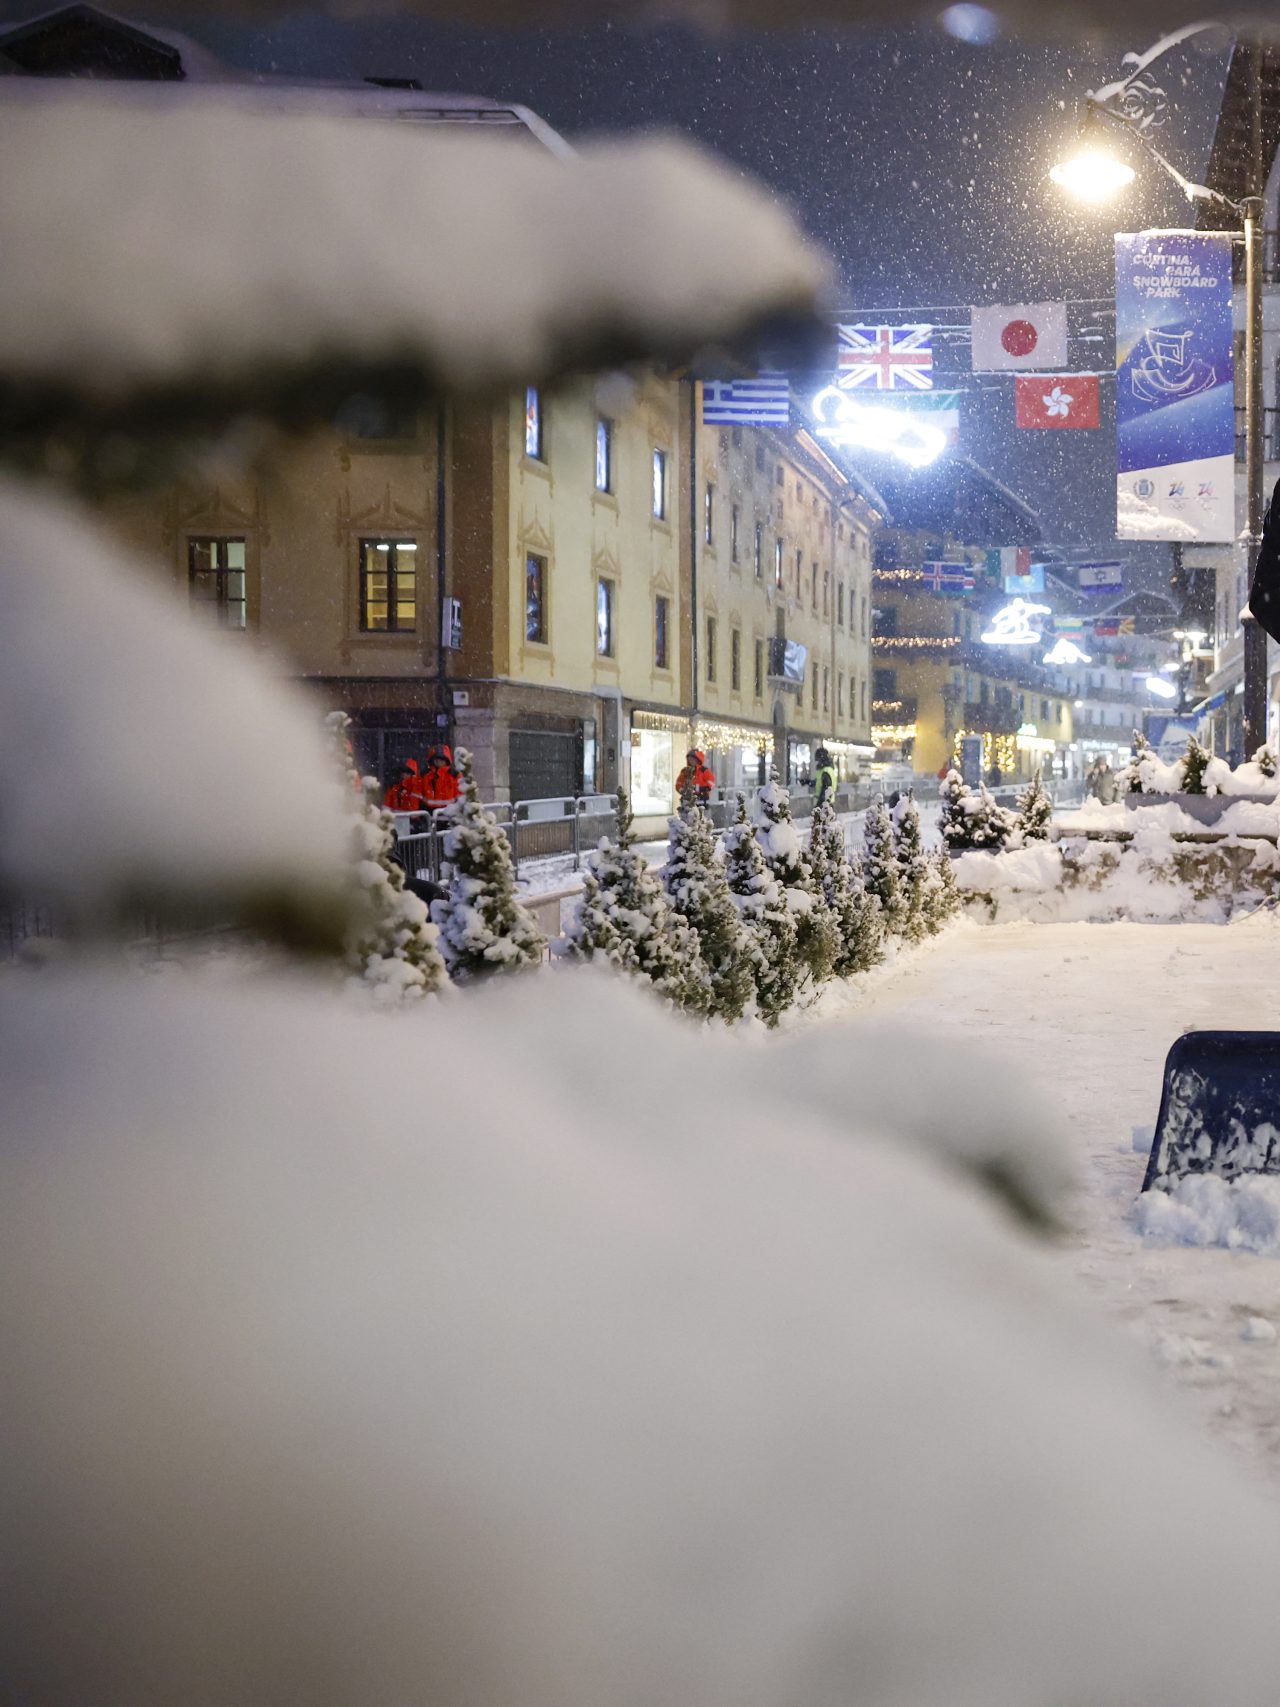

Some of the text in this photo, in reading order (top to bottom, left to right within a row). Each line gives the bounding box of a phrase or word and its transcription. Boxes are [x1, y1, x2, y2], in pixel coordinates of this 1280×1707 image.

[1133, 254, 1190, 265] CORTINA
[1133, 276, 1218, 288] SNOWBOARD
[1145, 287, 1182, 298] PARK
